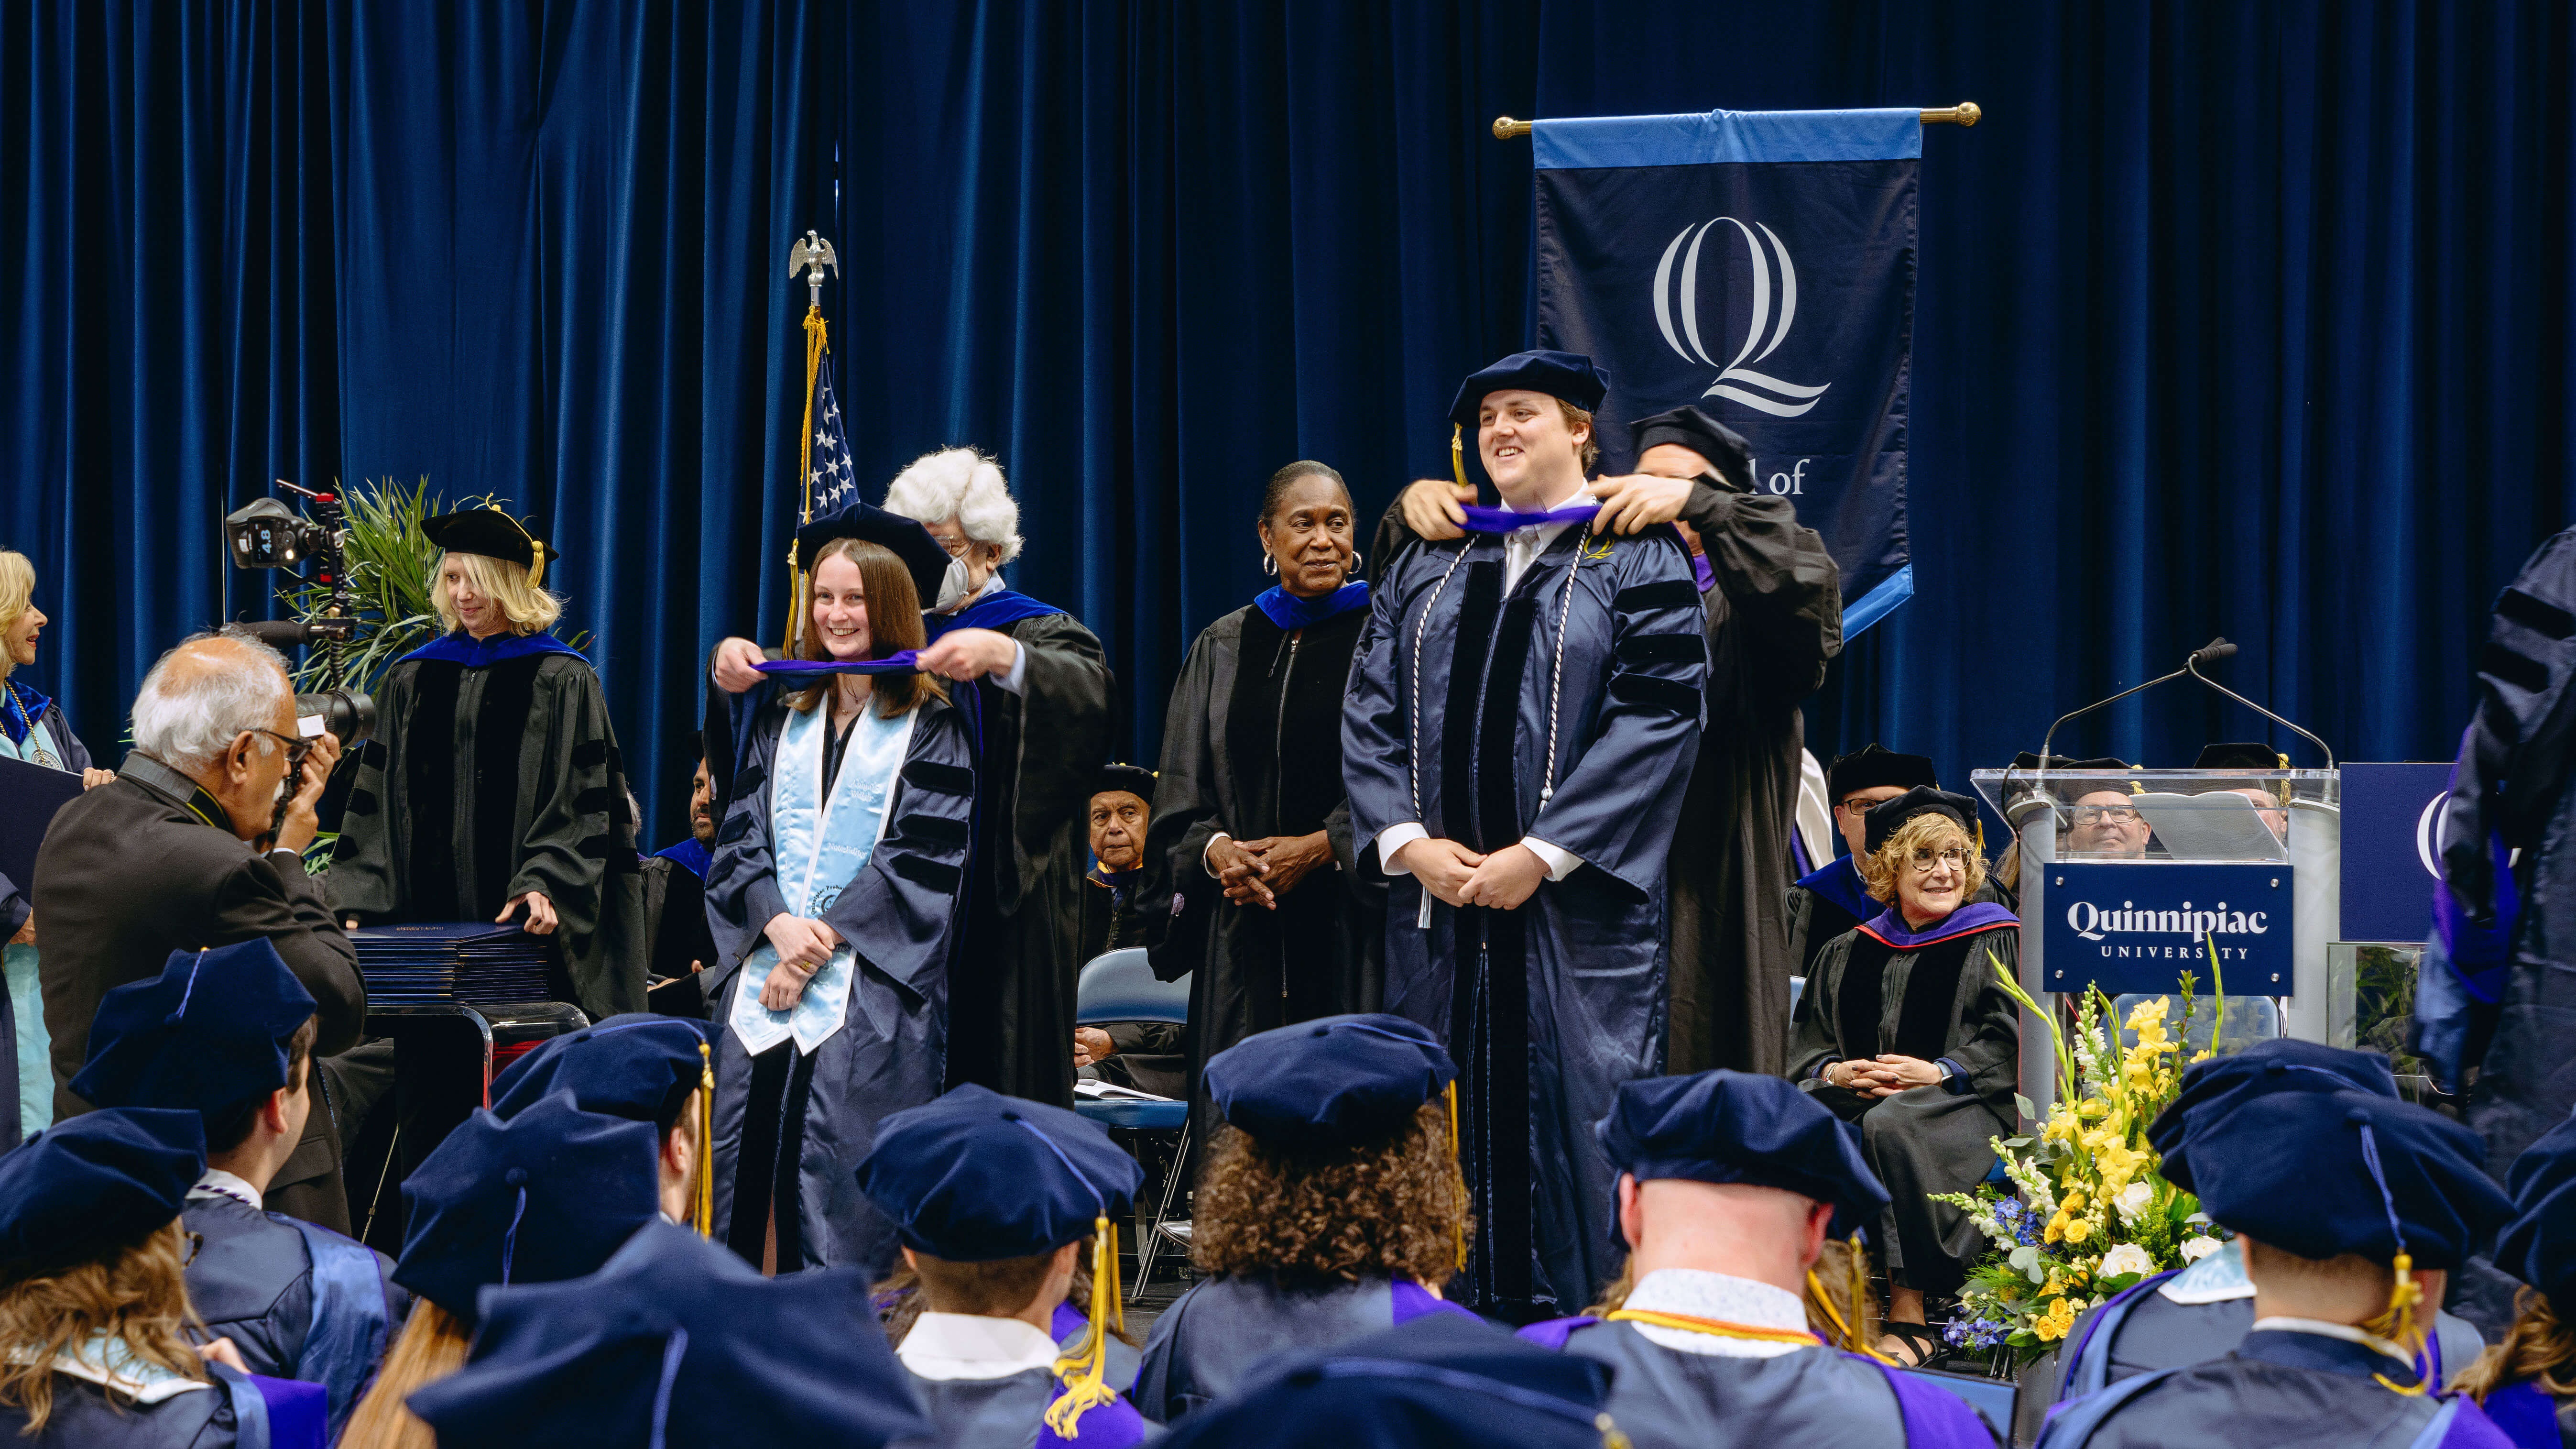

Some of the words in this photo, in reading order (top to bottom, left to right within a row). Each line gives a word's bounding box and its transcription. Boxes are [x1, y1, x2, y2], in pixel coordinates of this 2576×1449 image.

[1653, 217, 1831, 417] Q
[1769, 459, 1810, 495] of
[261, 529, 272, 554] 4.8
[2067, 900, 2268, 943] Quinnipiac
[2101, 945, 2248, 959] UNIVERSTY
